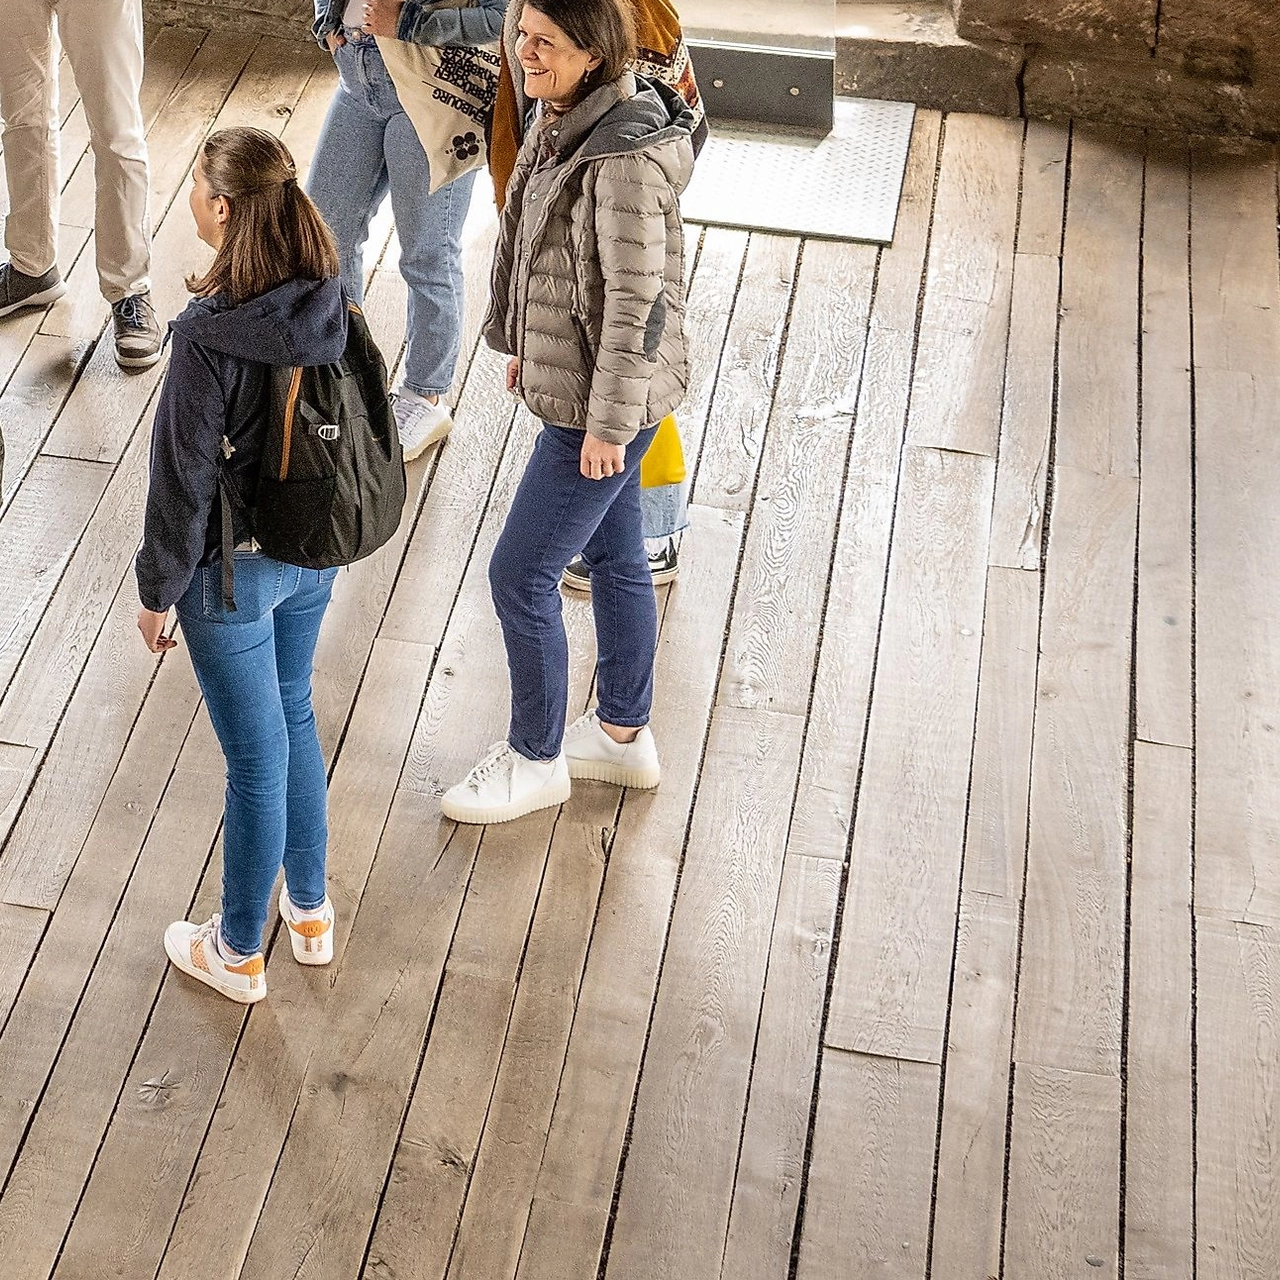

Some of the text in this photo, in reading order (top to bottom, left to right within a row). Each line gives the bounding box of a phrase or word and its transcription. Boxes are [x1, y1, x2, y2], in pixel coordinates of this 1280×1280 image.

[434, 68, 494, 103] RBRÜCKEN
[440, 61, 470, 80] TRIER
[432, 88, 486, 124] EMBOURG
